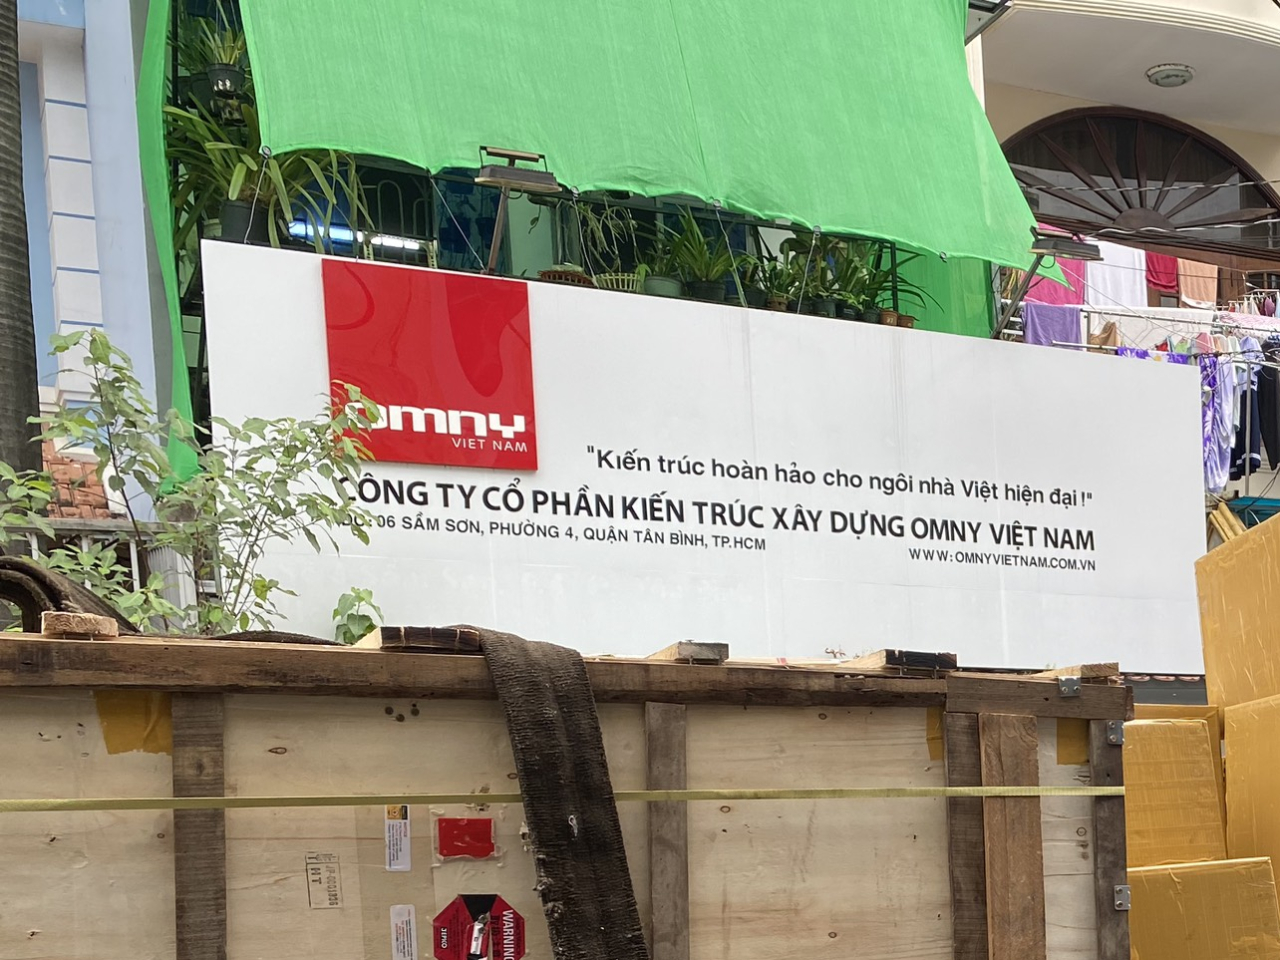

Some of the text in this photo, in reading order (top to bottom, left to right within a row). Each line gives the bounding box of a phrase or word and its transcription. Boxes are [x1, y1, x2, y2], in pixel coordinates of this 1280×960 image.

[452, 437, 528, 453] VIET NAM
[657, 455, 705, 476] trúc
[711, 458, 768, 481] hoàn
[775, 462, 816, 484] hảo
[823, 468, 863, 488] cho
[869, 473, 913, 496] ngôi
[919, 477, 955, 496] nhà
[961, 479, 998, 503] Việt
[1005, 483, 1044, 506] hiện
[435, 483, 477, 509] TY
[482, 477, 524, 513] CỔ
[532, 484, 614, 518] PHẦN
[621, 491, 685, 523] KIẾN
[692, 499, 765, 529] TRÚC
[771, 504, 823, 532] XÂY
[830, 510, 905, 540] DỰNG
[910, 517, 982, 544] OMNY
[989, 520, 1037, 550] VIỆT
[1043, 527, 1095, 551] NAM
[445, 518, 484, 536] SƠN,
[489, 518, 560, 539] PHƯỜNG
[564, 526, 579, 542] 4,
[583, 526, 628, 544] QUẬN
[633, 528, 665, 545] TÂN
[670, 530, 708, 548] BÌNH,
[711, 535, 766, 551] TP.HCM
